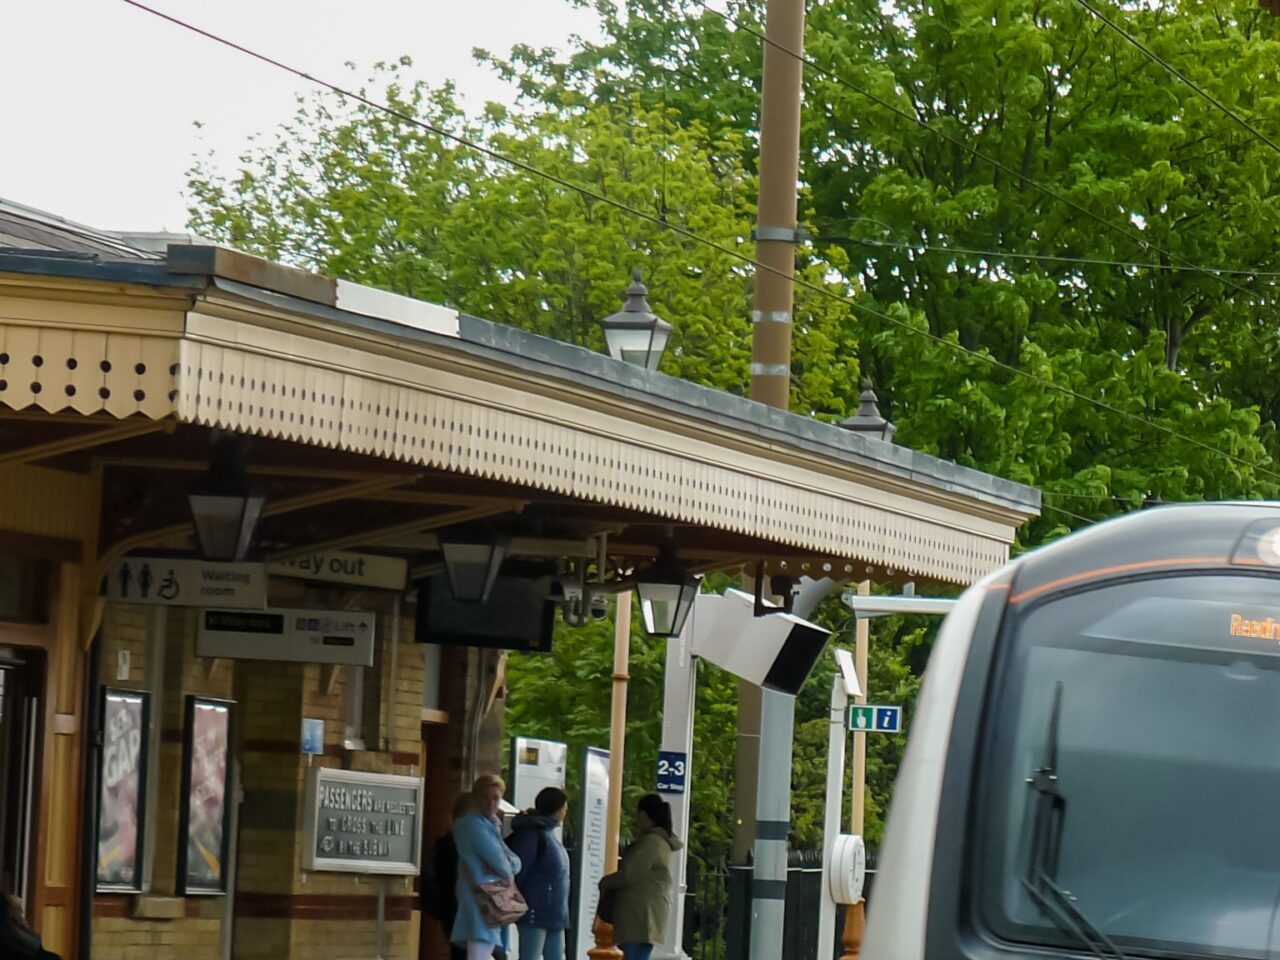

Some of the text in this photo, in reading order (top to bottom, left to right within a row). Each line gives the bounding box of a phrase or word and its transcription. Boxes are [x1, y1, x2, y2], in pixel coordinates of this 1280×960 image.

[279, 555, 365, 577] ay out
[201, 568, 250, 584] Waiting
[201, 586, 235, 597] room
[657, 760, 685, 776] 2-3
[319, 785, 373, 812] PASSENGERS
[341, 814, 367, 834] CROSS
[386, 818, 405, 836] LINE
